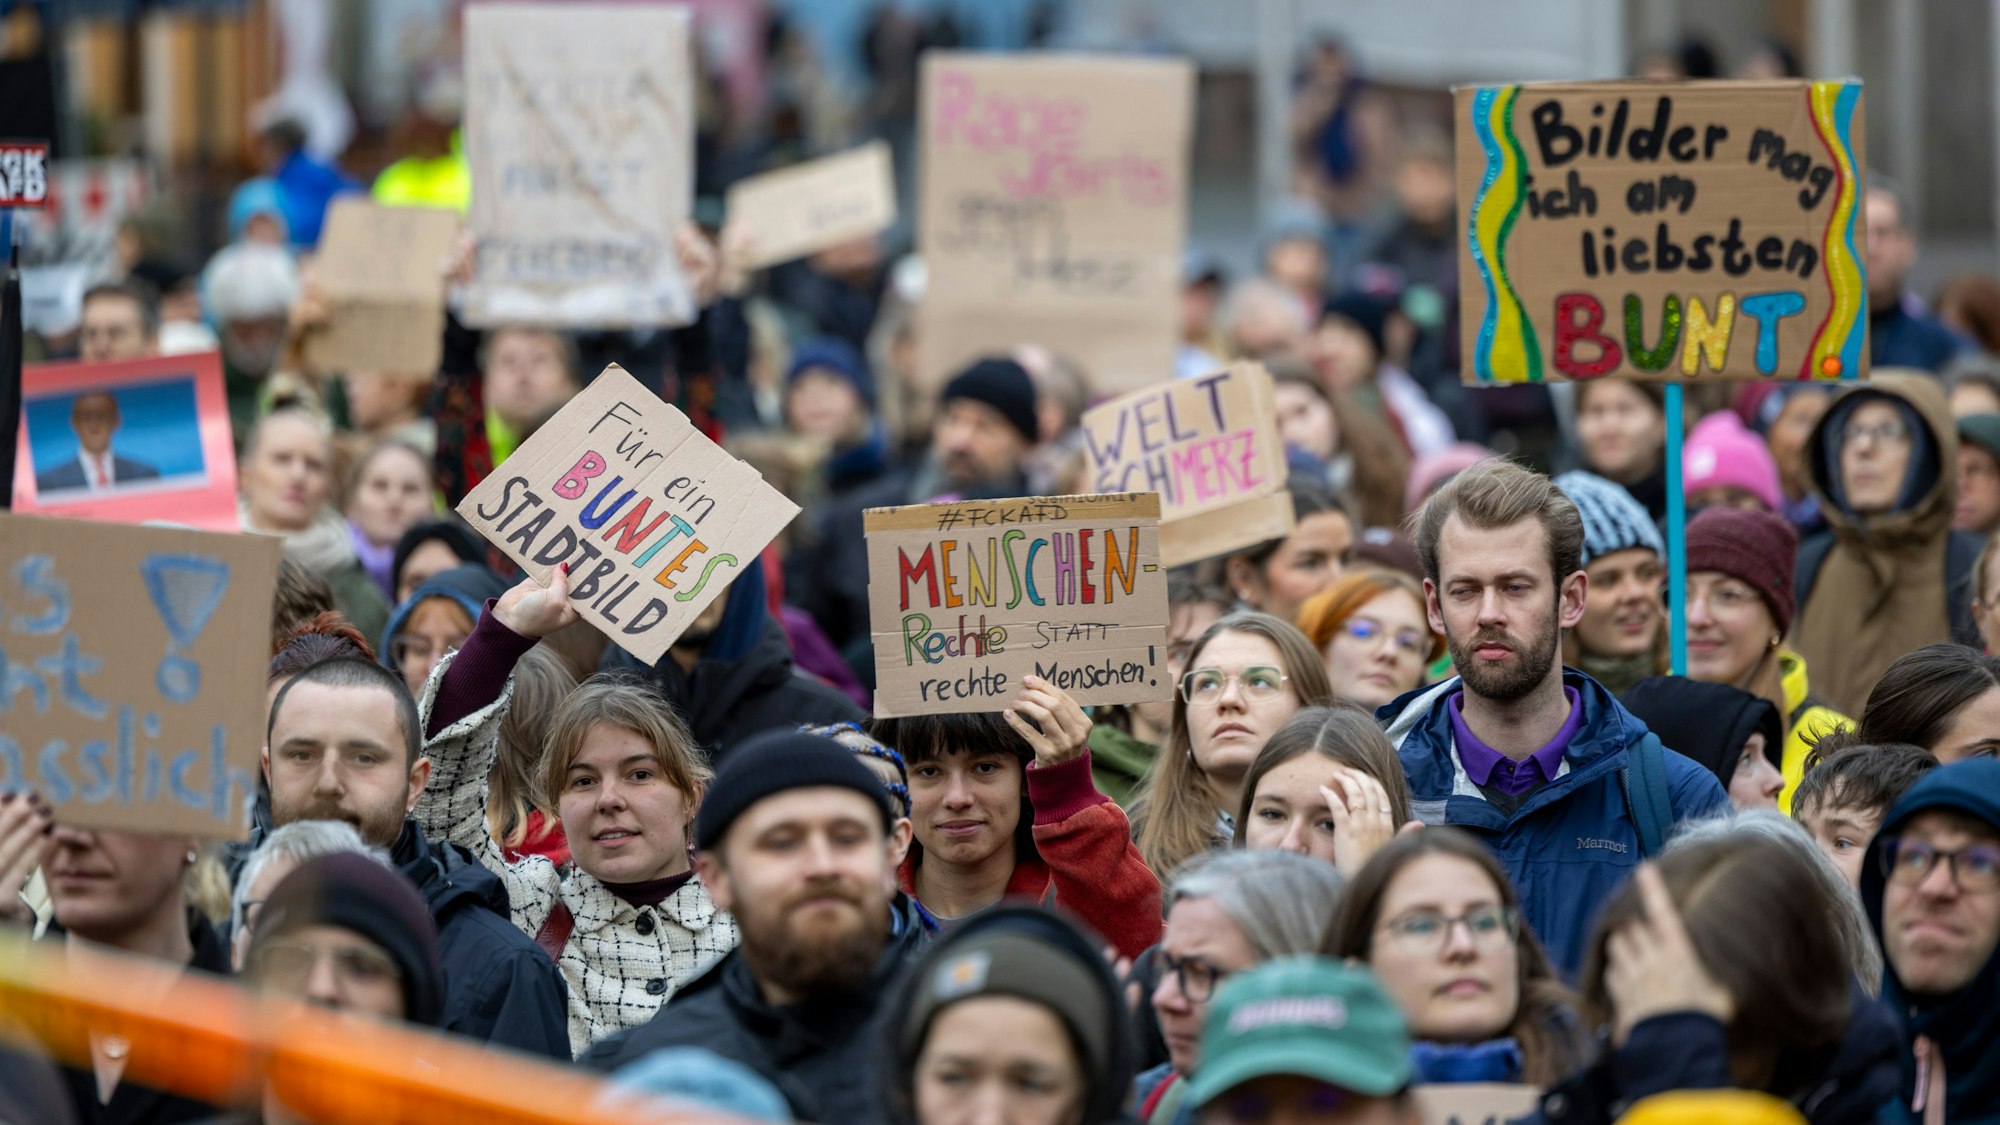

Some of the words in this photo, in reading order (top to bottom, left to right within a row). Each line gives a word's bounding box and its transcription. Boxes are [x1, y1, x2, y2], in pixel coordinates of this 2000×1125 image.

[1524, 170, 1597, 219] ich
[1625, 175, 1697, 215] am
[1531, 96, 1728, 168] Bilder
[1747, 128, 1834, 210] mag
[1581, 218, 1819, 279] liebsten
[1552, 291, 1806, 379] BUNT
[1084, 372, 1232, 467] WELT
[588, 401, 664, 469] Für
[664, 476, 716, 526] ein
[477, 476, 668, 635] STADTBILD
[552, 450, 739, 602] BUNTES
[938, 503, 1069, 531] #FCKAFD
[898, 526, 1158, 612] MENSCHEN-
[902, 613, 1008, 667] Rechte
[1031, 621, 1119, 650] STATT
[919, 666, 1008, 702] rechte
[1034, 645, 1158, 691] Menschen!
[1576, 837, 1628, 854] Marmot
